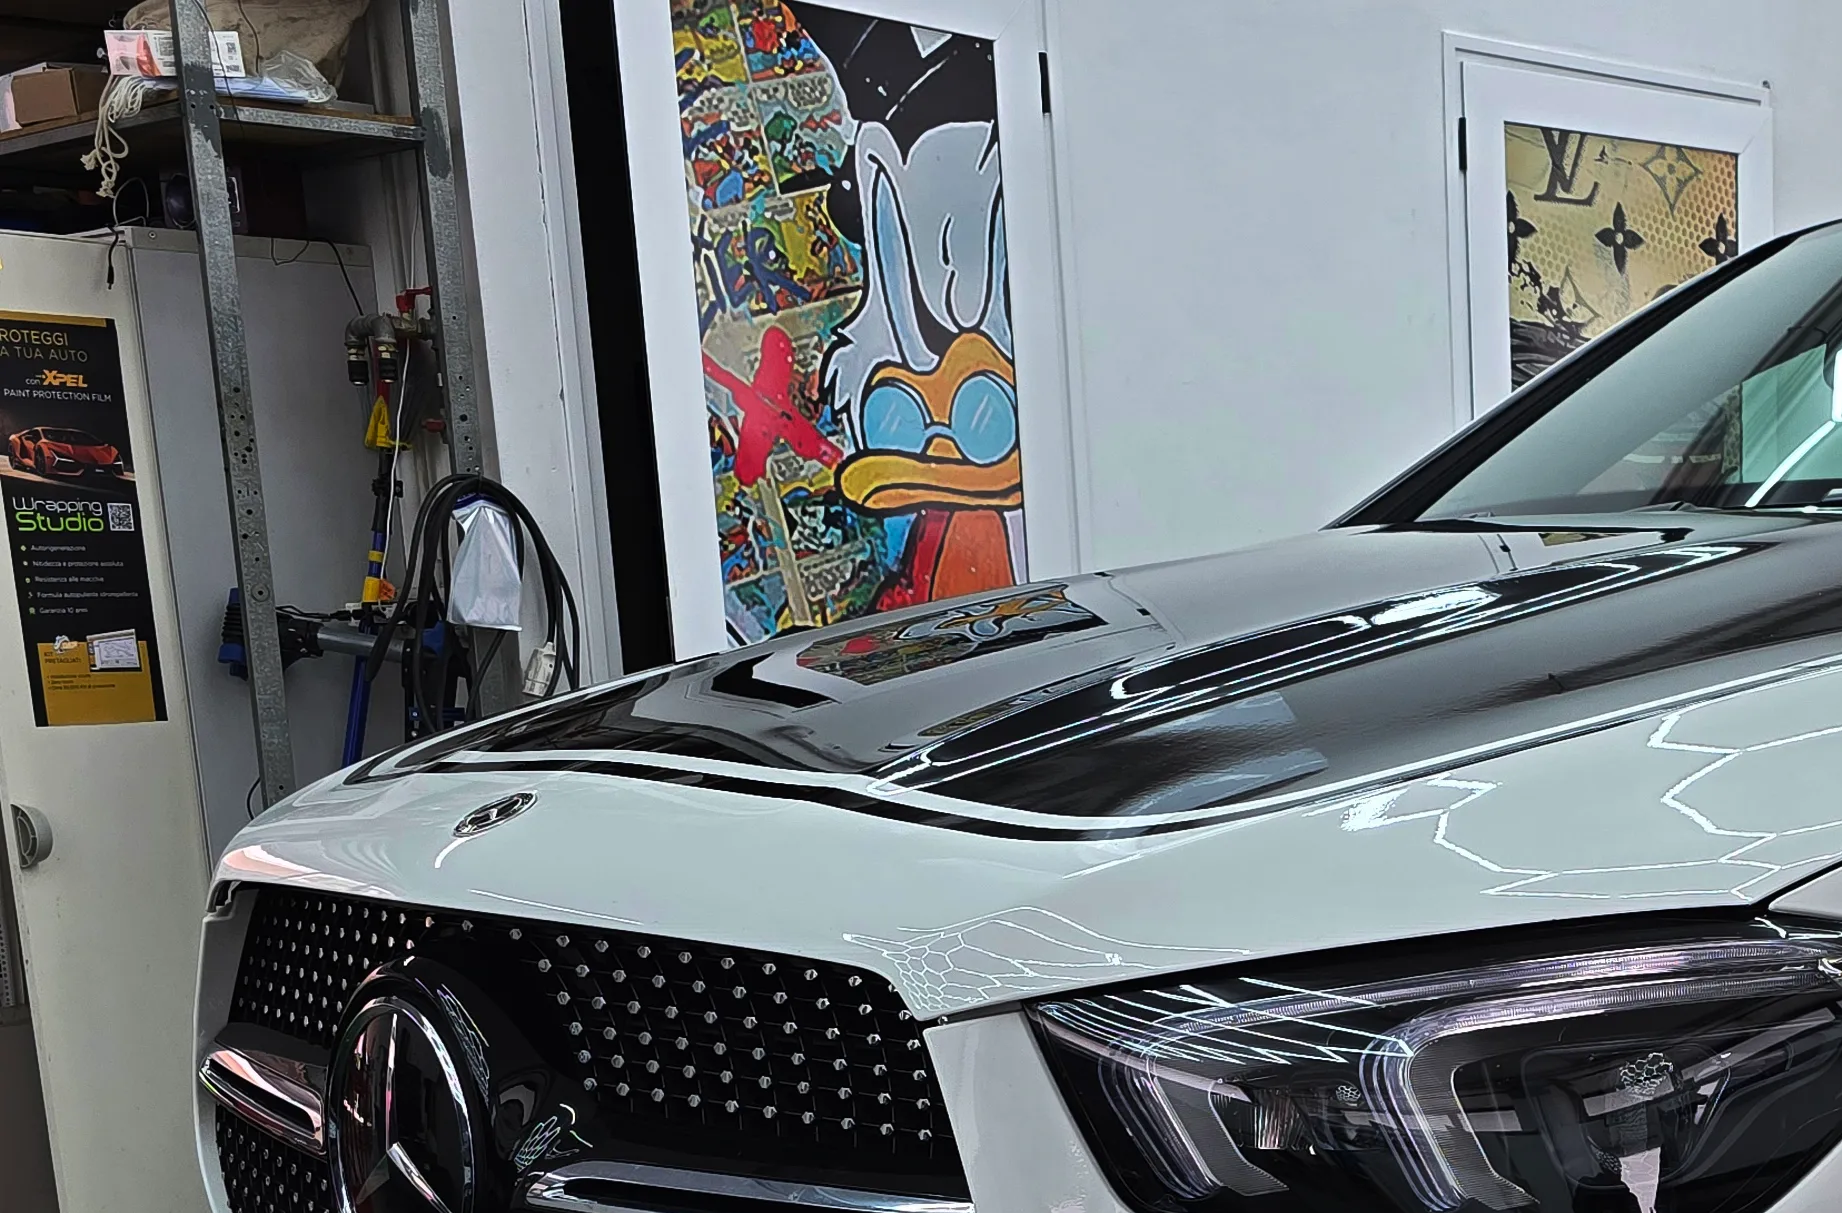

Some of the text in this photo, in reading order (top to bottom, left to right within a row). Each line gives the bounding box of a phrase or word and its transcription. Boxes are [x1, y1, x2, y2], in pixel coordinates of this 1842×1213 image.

[14, 346, 44, 359] TUA
[49, 349, 88, 363] AUTO
[25, 369, 88, 388] con XPEL
[3, 388, 112, 402] PAINT PROTECTION FILM
[12, 496, 103, 516] Wrapping
[15, 511, 104, 532] Studio
